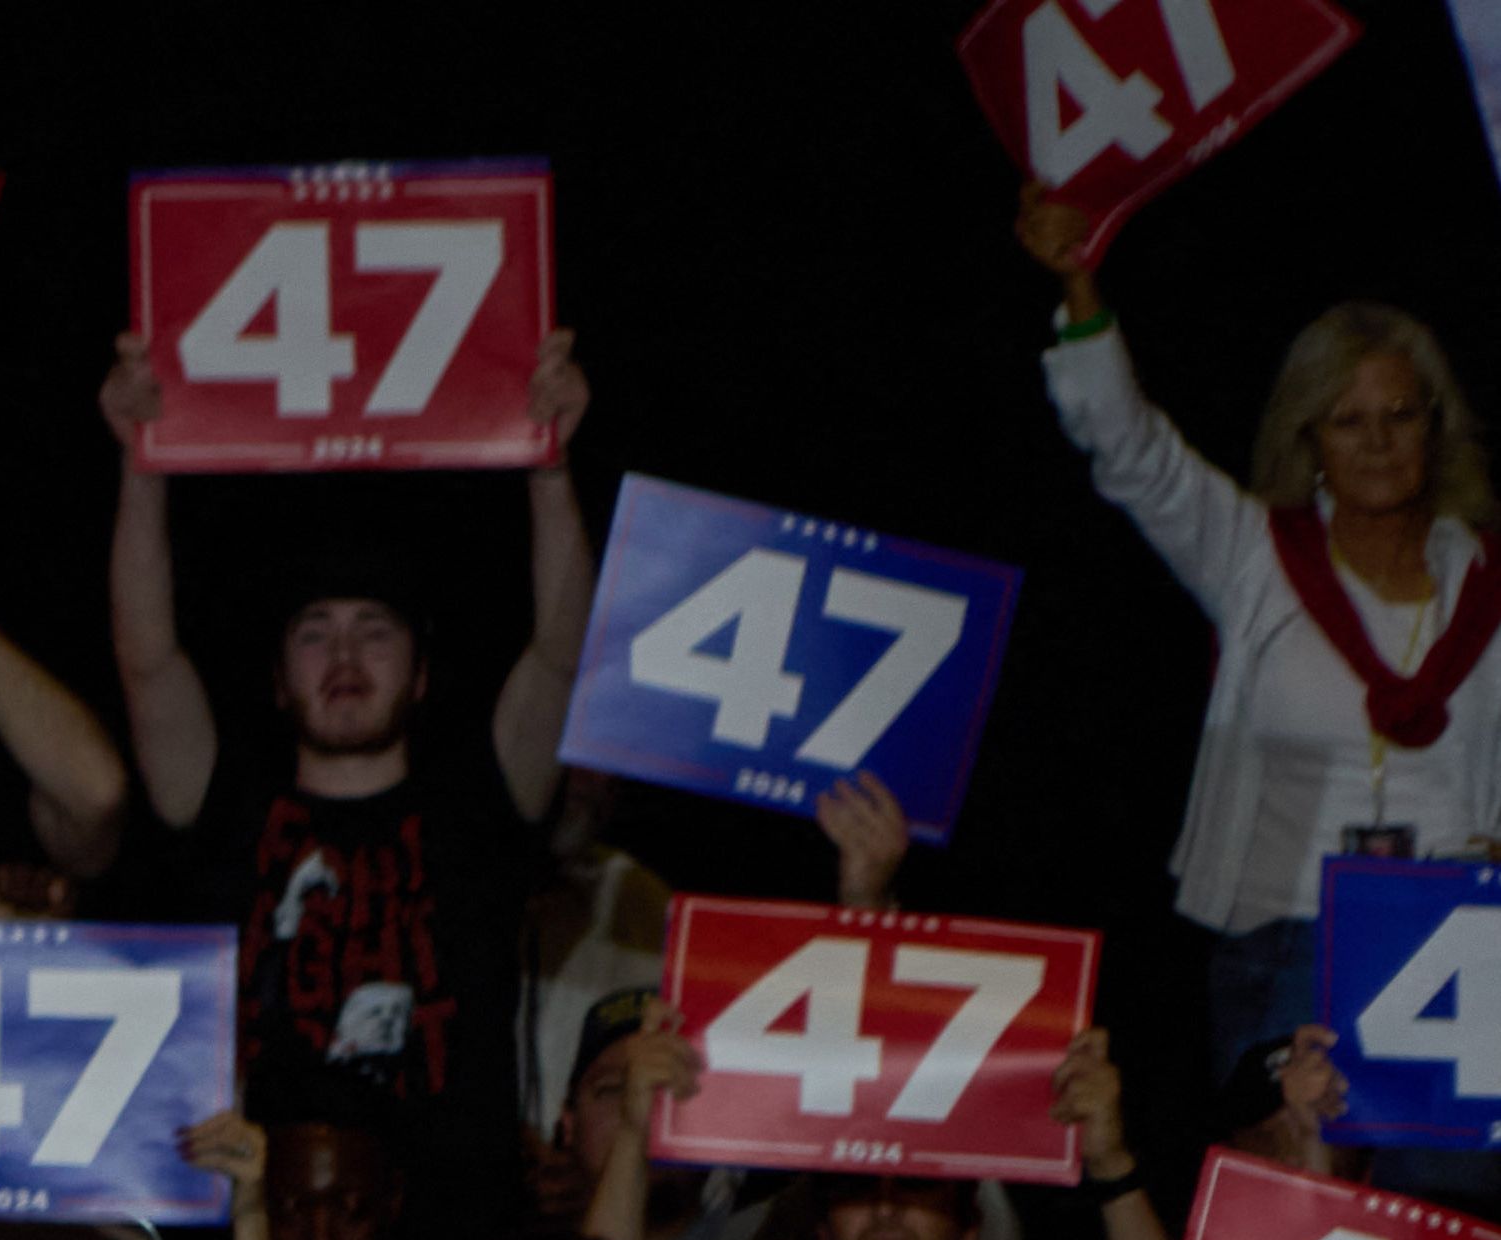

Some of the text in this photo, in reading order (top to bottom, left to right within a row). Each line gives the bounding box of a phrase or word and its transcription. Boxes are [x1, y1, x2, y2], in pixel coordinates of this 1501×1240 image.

[1020, 0, 1238, 192] 47
[176, 219, 506, 419] 47
[630, 546, 970, 772] 47
[705, 934, 1046, 1122] 47
[832, 1138, 902, 1165] 2024
